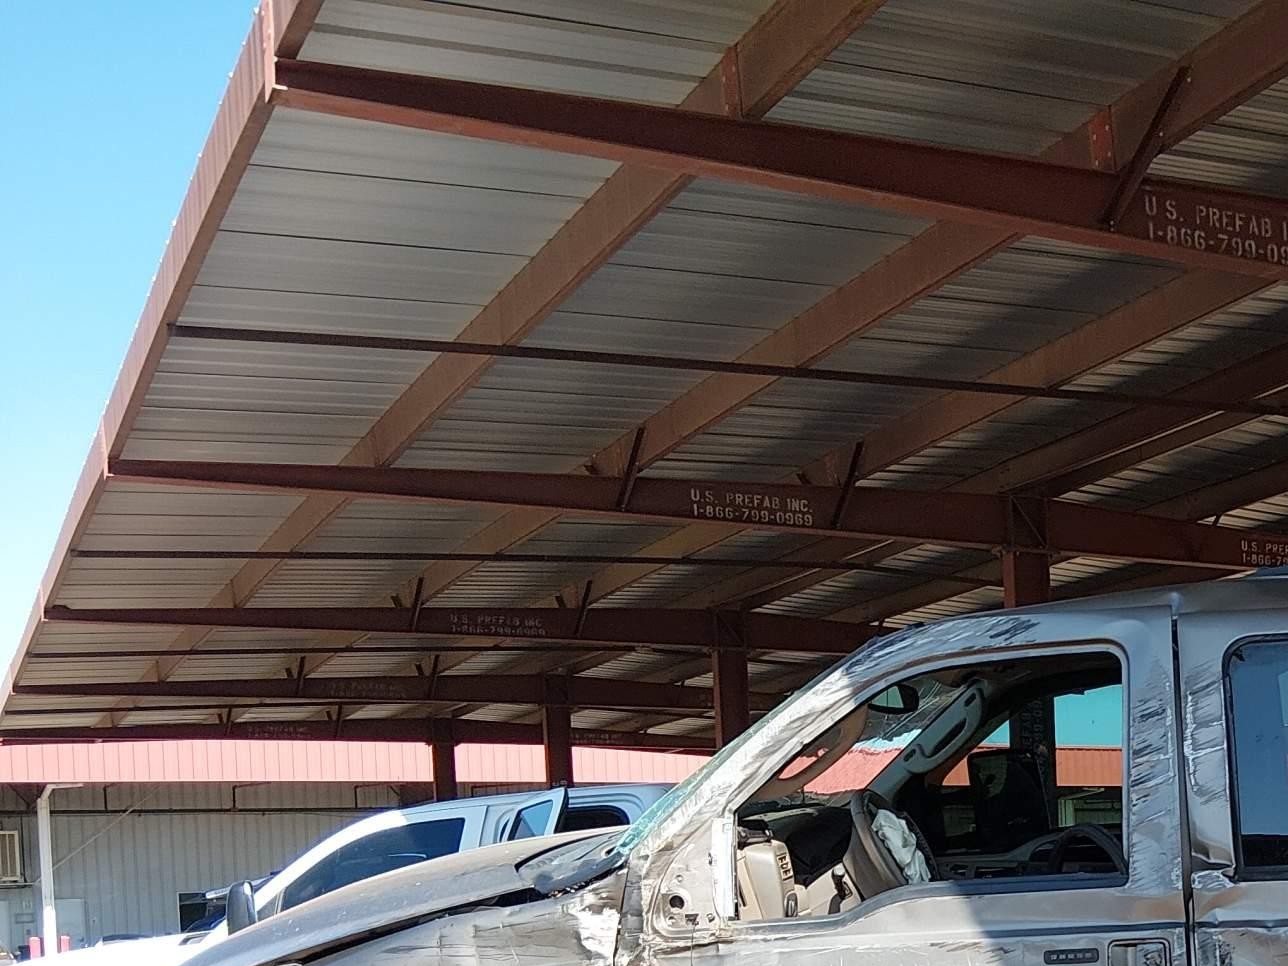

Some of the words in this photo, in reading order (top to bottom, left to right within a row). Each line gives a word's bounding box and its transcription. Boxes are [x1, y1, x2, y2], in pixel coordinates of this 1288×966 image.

[1196, 205, 1273, 239] PREFAB
[690, 487, 718, 504] U.S.
[726, 492, 781, 510] PREFAB
[786, 498, 813, 513] INC.
[692, 504, 813, 527] 1-866-799-0969
